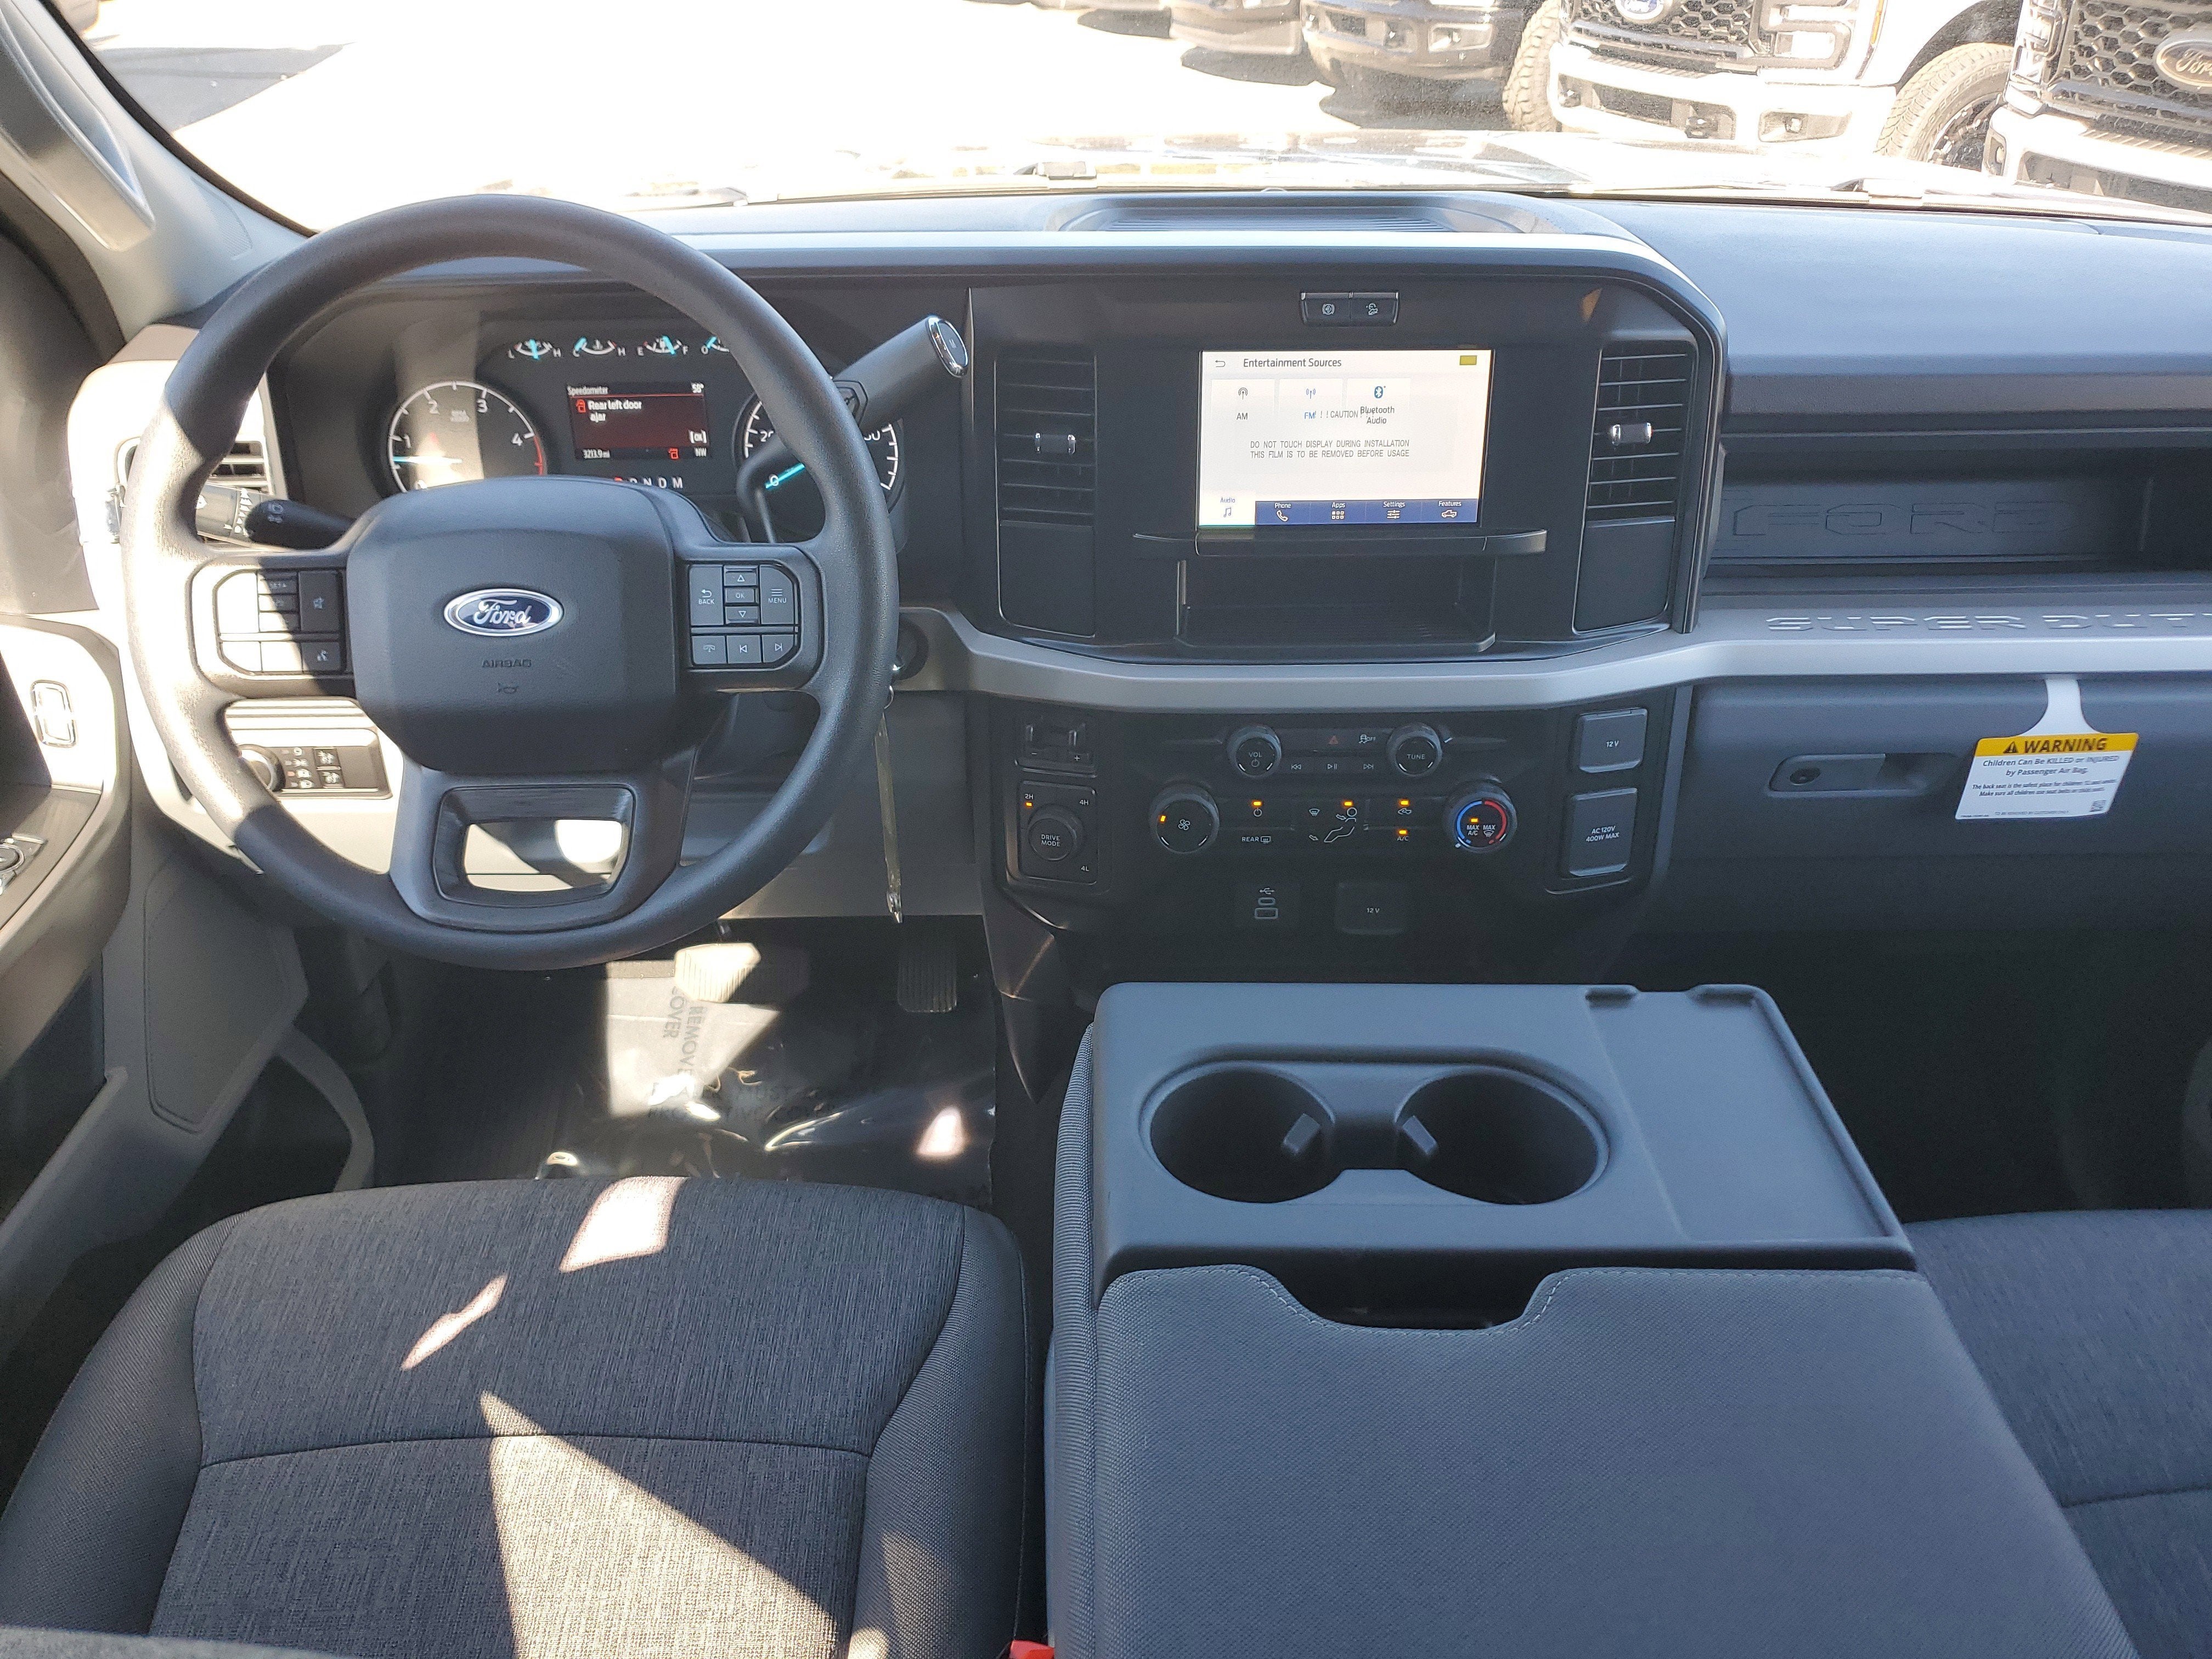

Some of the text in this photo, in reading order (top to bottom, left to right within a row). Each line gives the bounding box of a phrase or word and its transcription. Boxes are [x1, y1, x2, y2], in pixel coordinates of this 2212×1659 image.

[618, 347, 627, 357] H
[637, 346, 644, 357] E
[1243, 358, 1342, 367] Entertainment Sources
[567, 385, 608, 396] Speedometer
[428, 399, 440, 414] 2
[476, 398, 488, 413] 3
[588, 399, 642, 410] Rear left door
[590, 411, 606, 422] ajar
[511, 432, 523, 447] 4
[1364, 439, 1410, 448] INSTALLATION
[672, 476, 684, 489] M
[1733, 500, 2076, 536] FORD
[473, 599, 532, 625] Ford
[1766, 613, 2212, 631] SUPER DUT
[2024, 737, 2108, 754] WARNING
[1605, 832, 1620, 840] MAX
